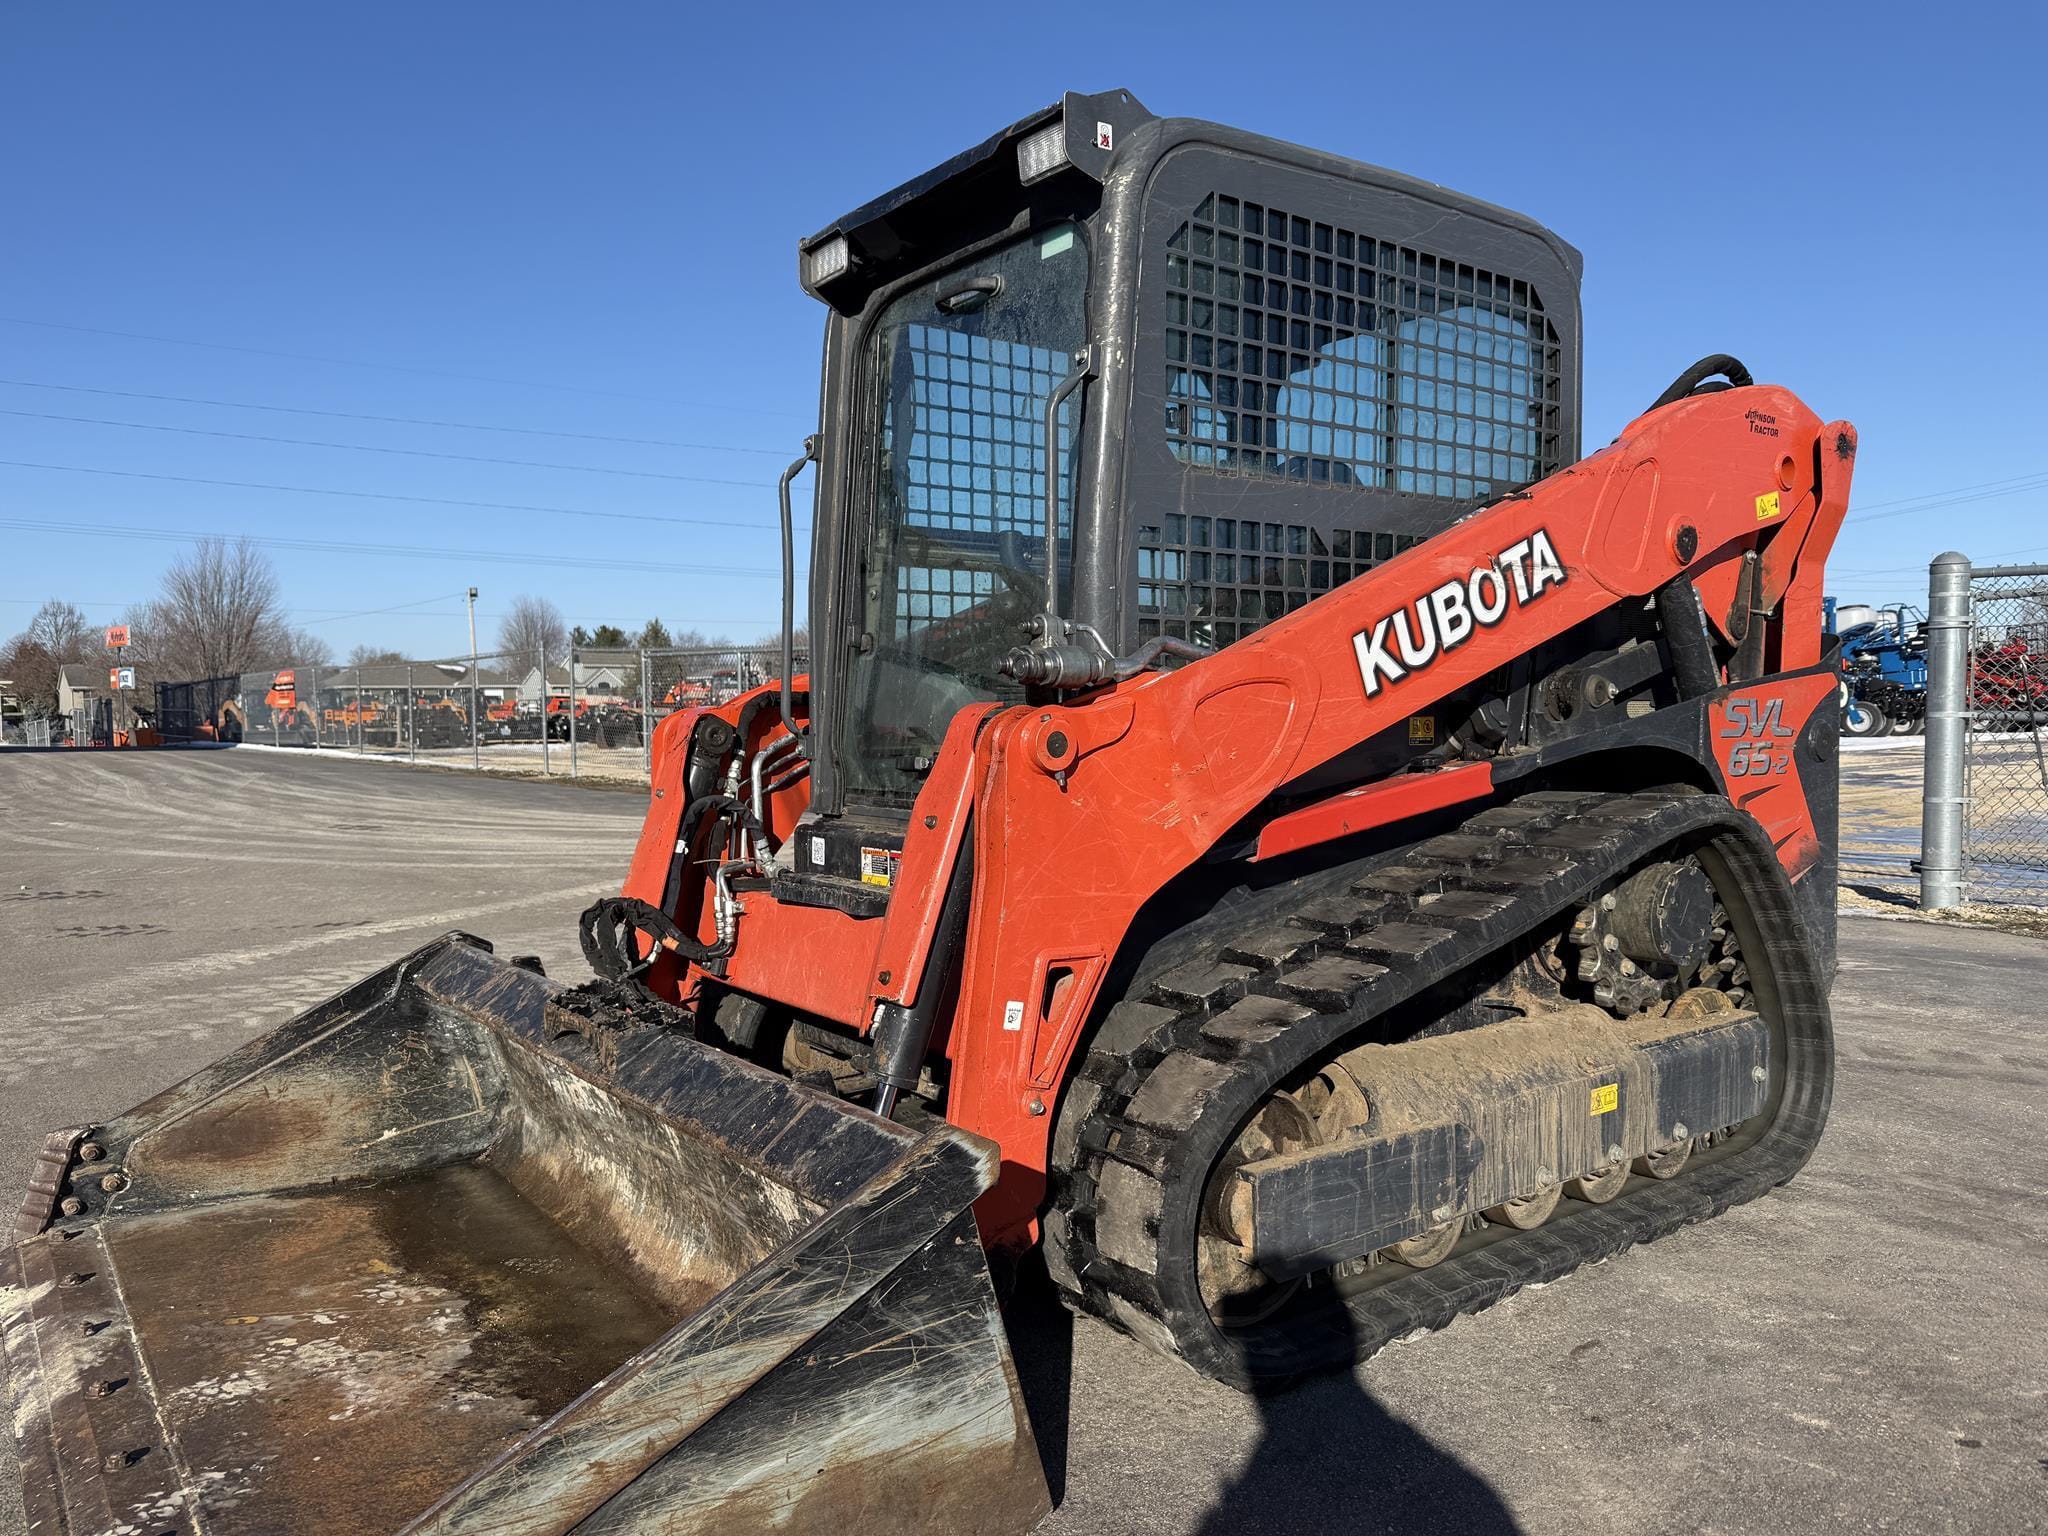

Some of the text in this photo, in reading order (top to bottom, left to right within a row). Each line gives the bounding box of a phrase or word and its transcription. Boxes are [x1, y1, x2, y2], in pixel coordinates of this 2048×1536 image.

[1745, 409, 1776, 424] JOHNSON
[1750, 421, 1779, 437] TRACTOR
[1352, 528, 1567, 698] KUBOTA
[1721, 698, 1793, 737] SVL
